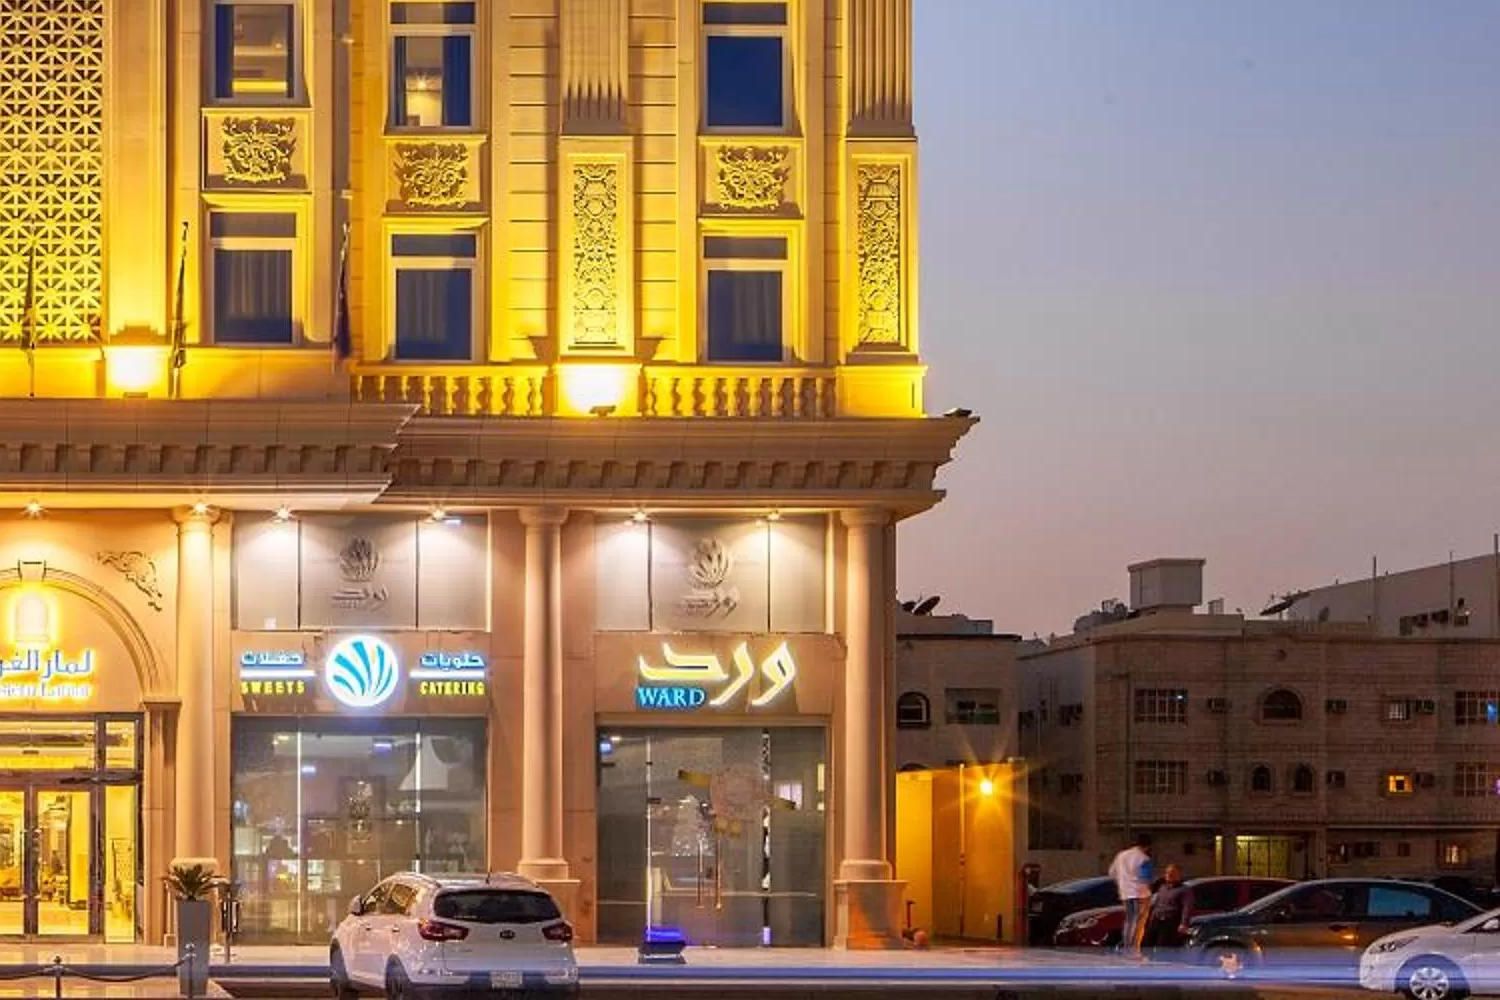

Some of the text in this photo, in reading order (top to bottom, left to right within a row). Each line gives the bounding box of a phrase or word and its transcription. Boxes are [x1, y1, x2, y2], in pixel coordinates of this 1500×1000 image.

[41, 649, 91, 679] لمار
[420, 651, 485, 672] حلويات
[638, 641, 797, 706] ورد
[240, 680, 305, 695] SWEETS
[420, 681, 485, 696] CATERING
[637, 687, 706, 706] WARD
